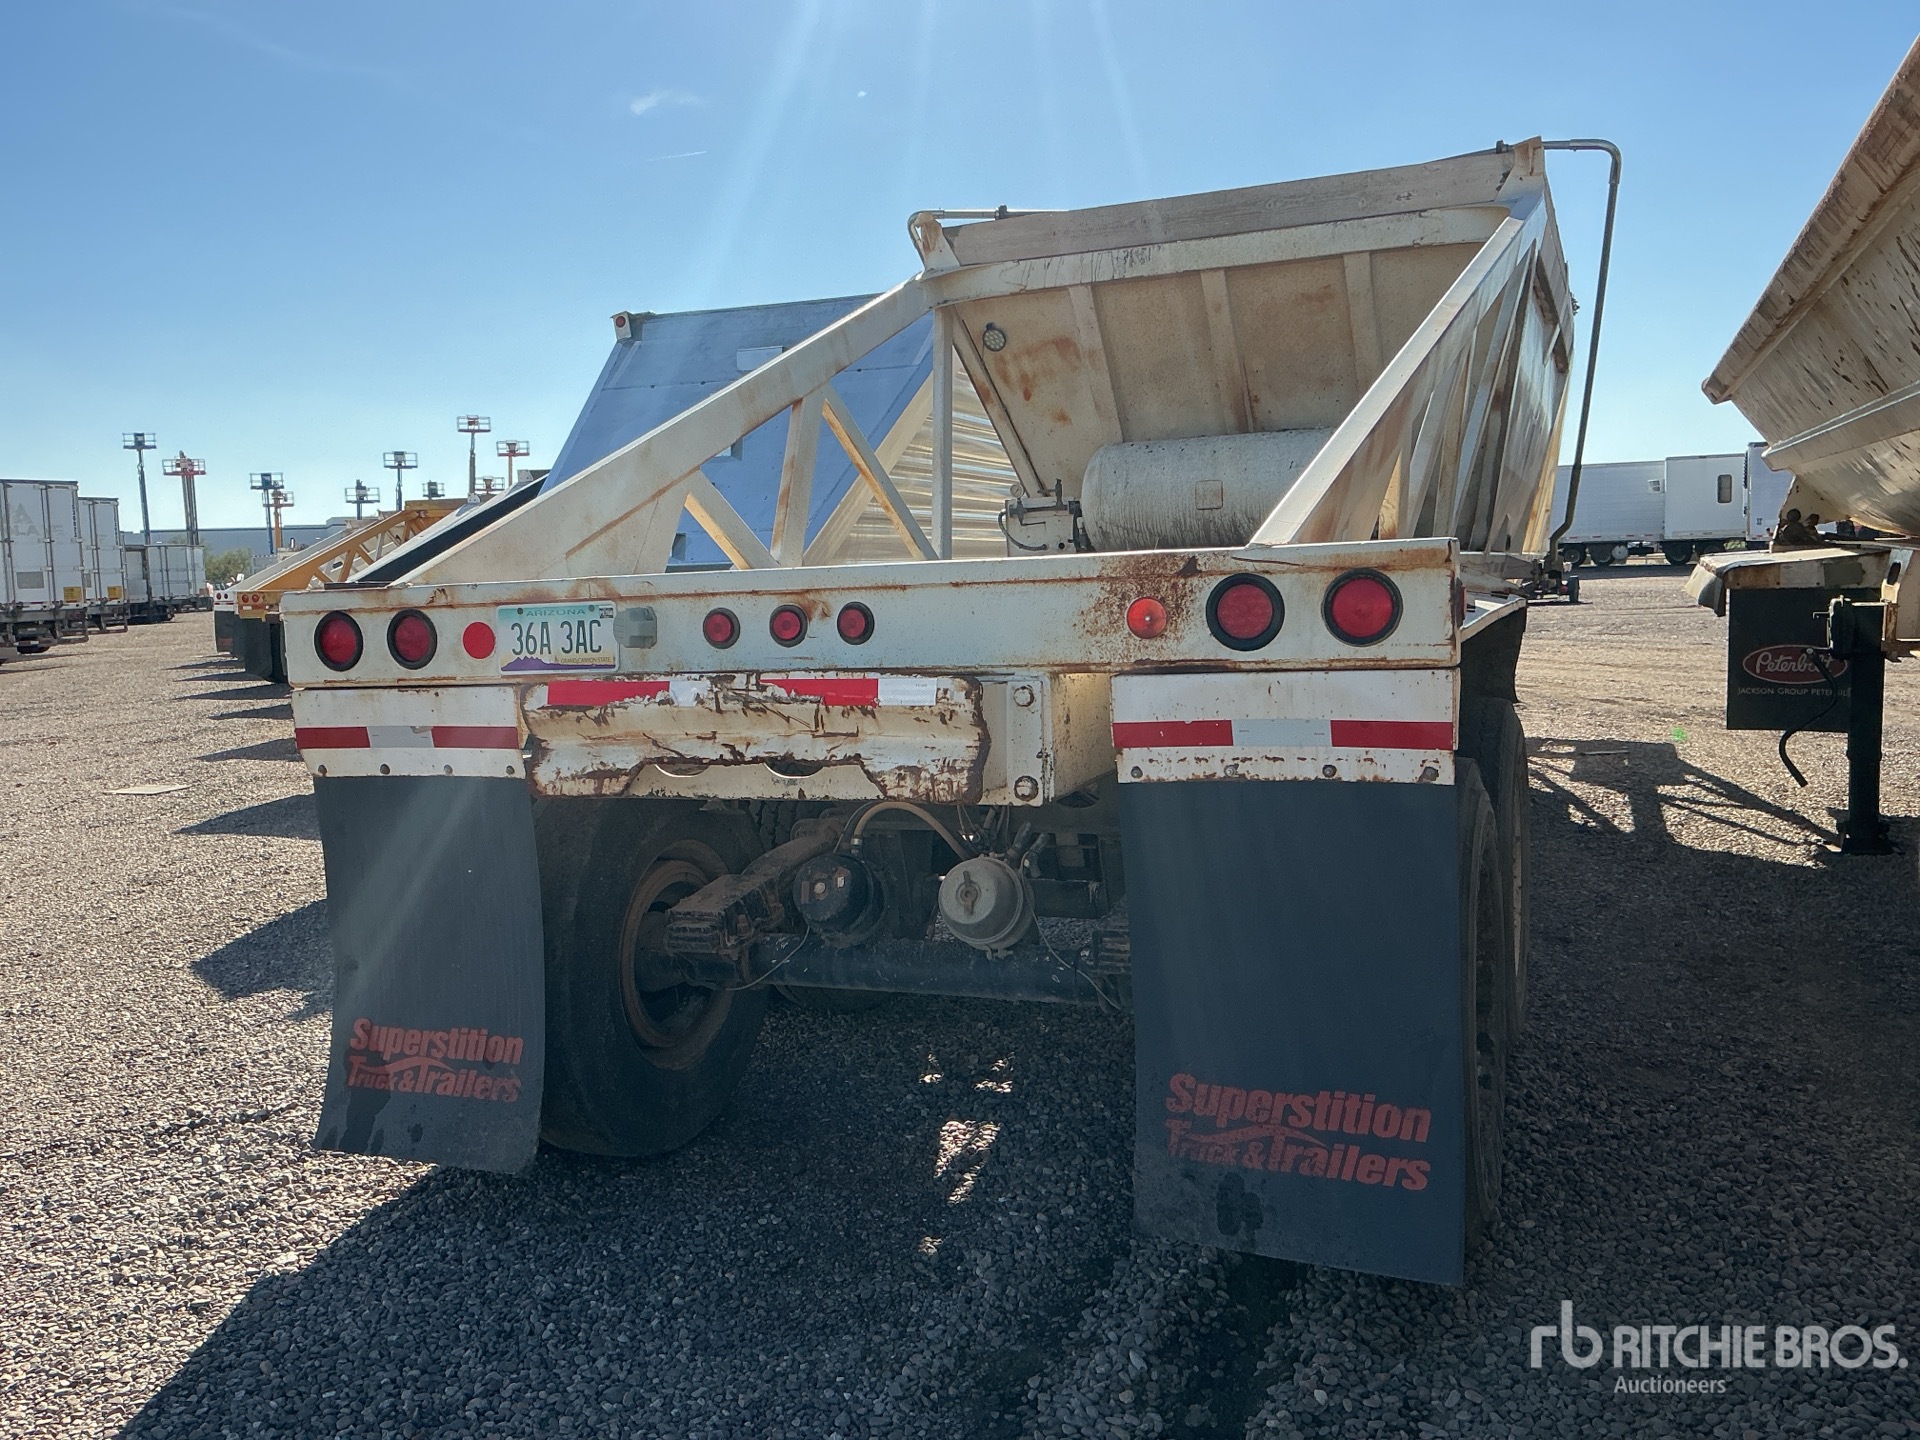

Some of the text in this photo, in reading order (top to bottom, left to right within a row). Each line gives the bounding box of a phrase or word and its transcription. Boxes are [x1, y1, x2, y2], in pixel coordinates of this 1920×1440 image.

[526, 608, 586, 617] ARIZONA
[511, 620, 602, 656] 36A 3AC
[1737, 687, 1775, 696] JACKSON
[1777, 687, 1809, 696] GROUP
[350, 1017, 524, 1065] Superstition
[348, 1055, 522, 1103] Truck & Trailers
[1165, 1072, 1432, 1143] Superstition
[1164, 1118, 1431, 1191] Truck & Trailers
